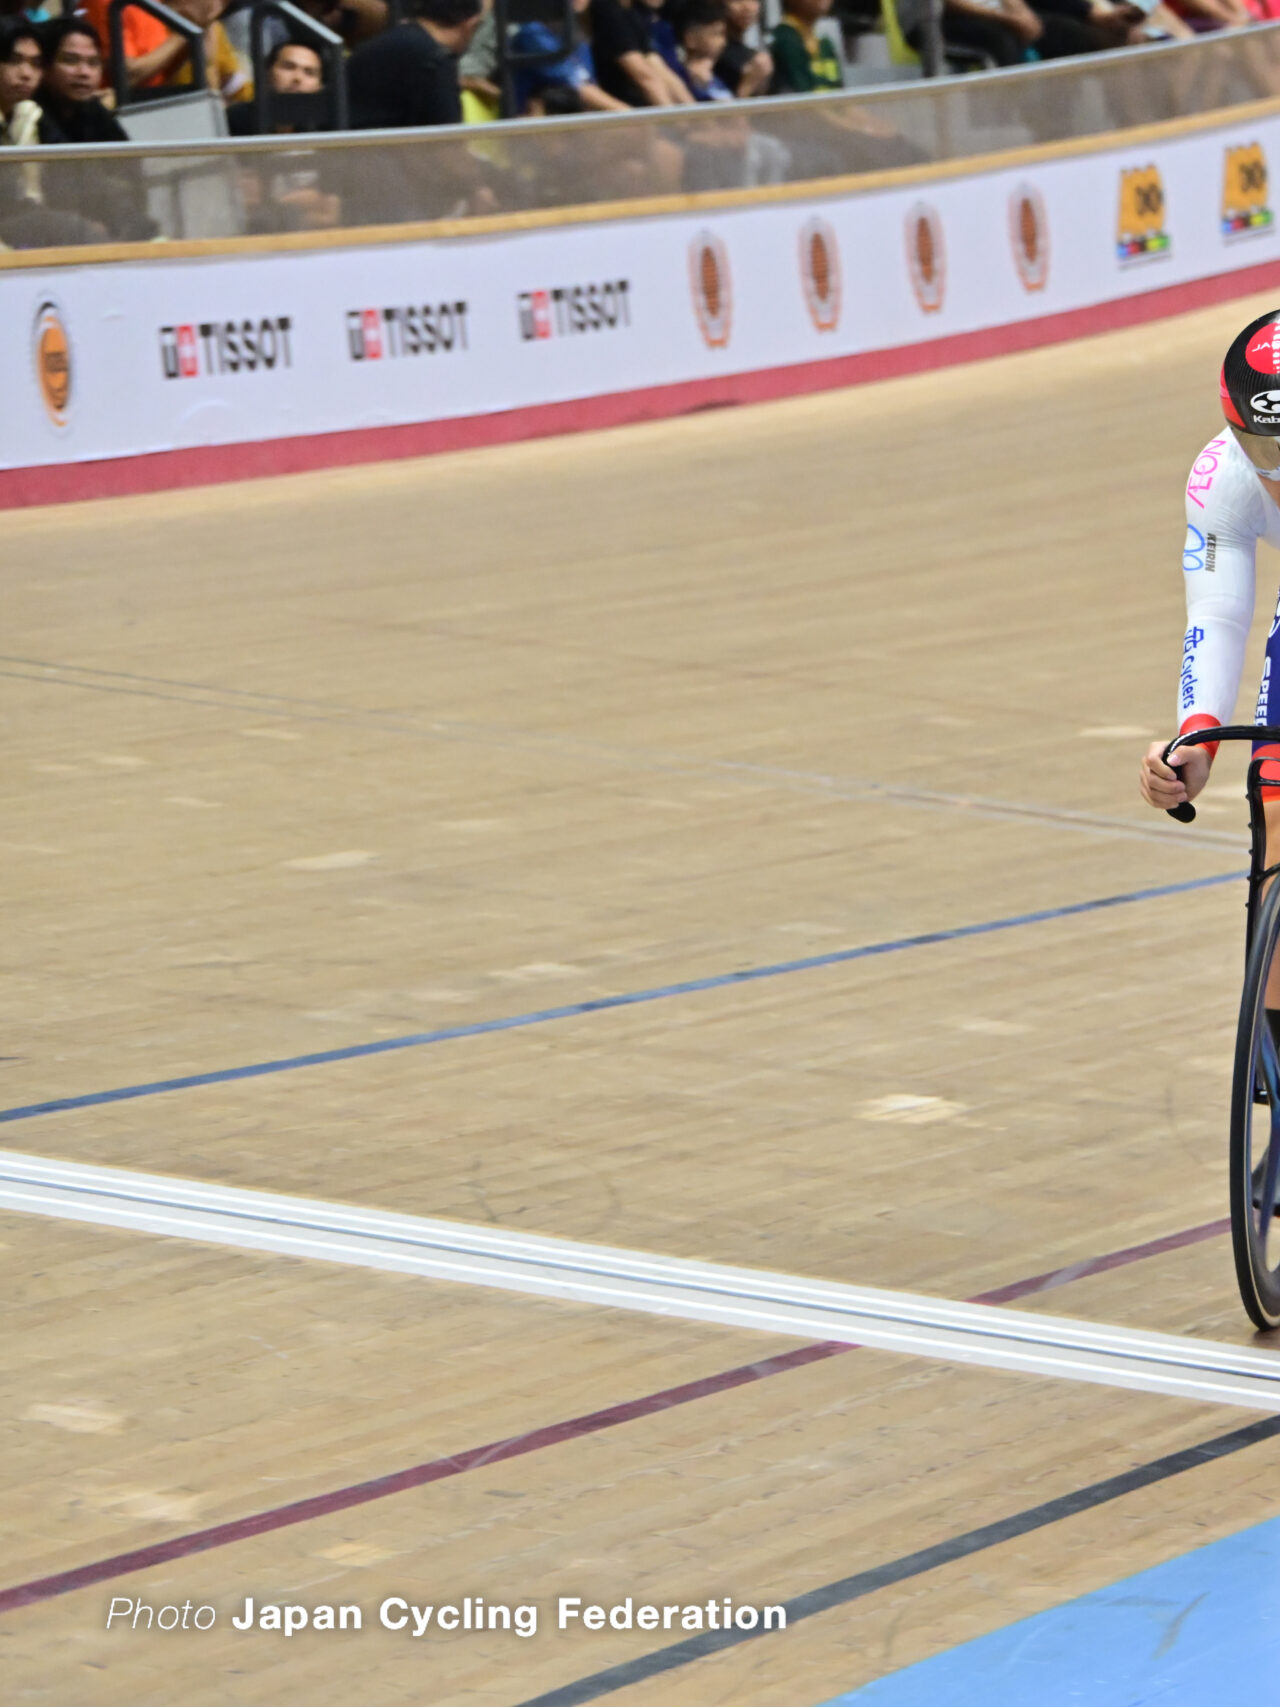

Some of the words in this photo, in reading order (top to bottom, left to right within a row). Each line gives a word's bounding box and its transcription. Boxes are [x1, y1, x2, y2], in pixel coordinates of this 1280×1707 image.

[383, 302, 468, 358] TISSOT
[550, 280, 632, 337] TISSOT
[199, 317, 291, 375] TISSOT
[1204, 532, 1217, 573] KEIRIN
